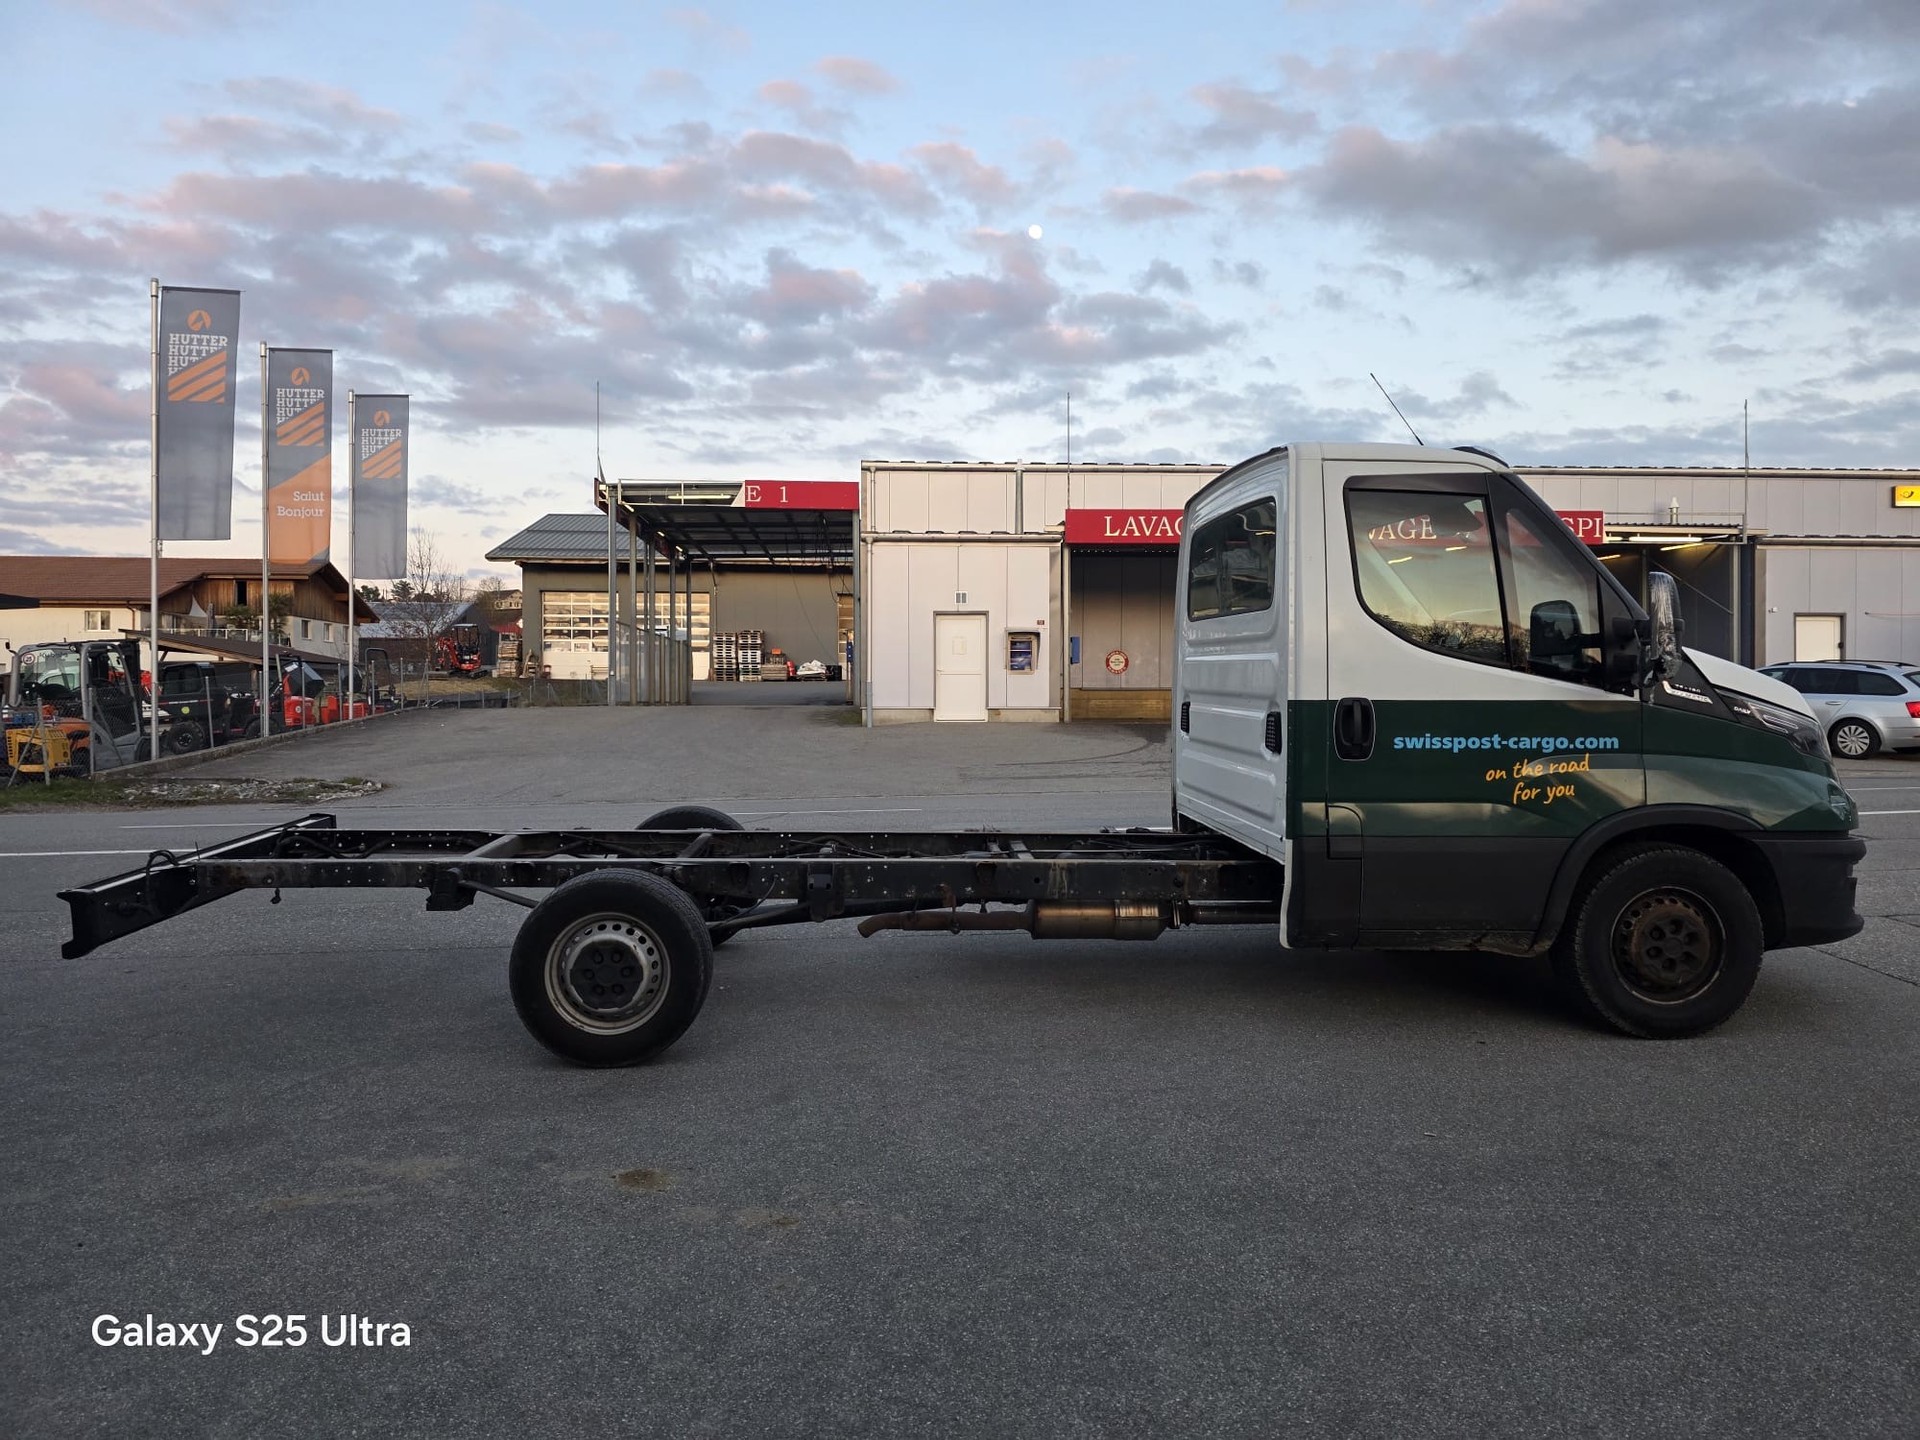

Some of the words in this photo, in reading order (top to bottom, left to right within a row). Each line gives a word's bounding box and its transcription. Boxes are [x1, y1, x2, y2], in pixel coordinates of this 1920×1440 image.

[169, 333, 228, 346] HUTTER
[168, 345, 222, 356] HUTTE
[168, 356, 202, 367] HUT
[276, 388, 325, 399] HUTTER
[361, 428, 402, 437] HUTTER
[293, 490, 325, 502] Salut
[746, 485, 762, 502] E
[779, 486, 789, 503] 1
[277, 505, 325, 518] Bonjour
[1393, 733, 1619, 753] swisspost-cargo.com
[1485, 768, 1507, 782] on
[1513, 758, 1544, 779] the
[1549, 753, 1590, 773] road
[1512, 782, 1541, 804] for
[1543, 783, 1576, 804] you
